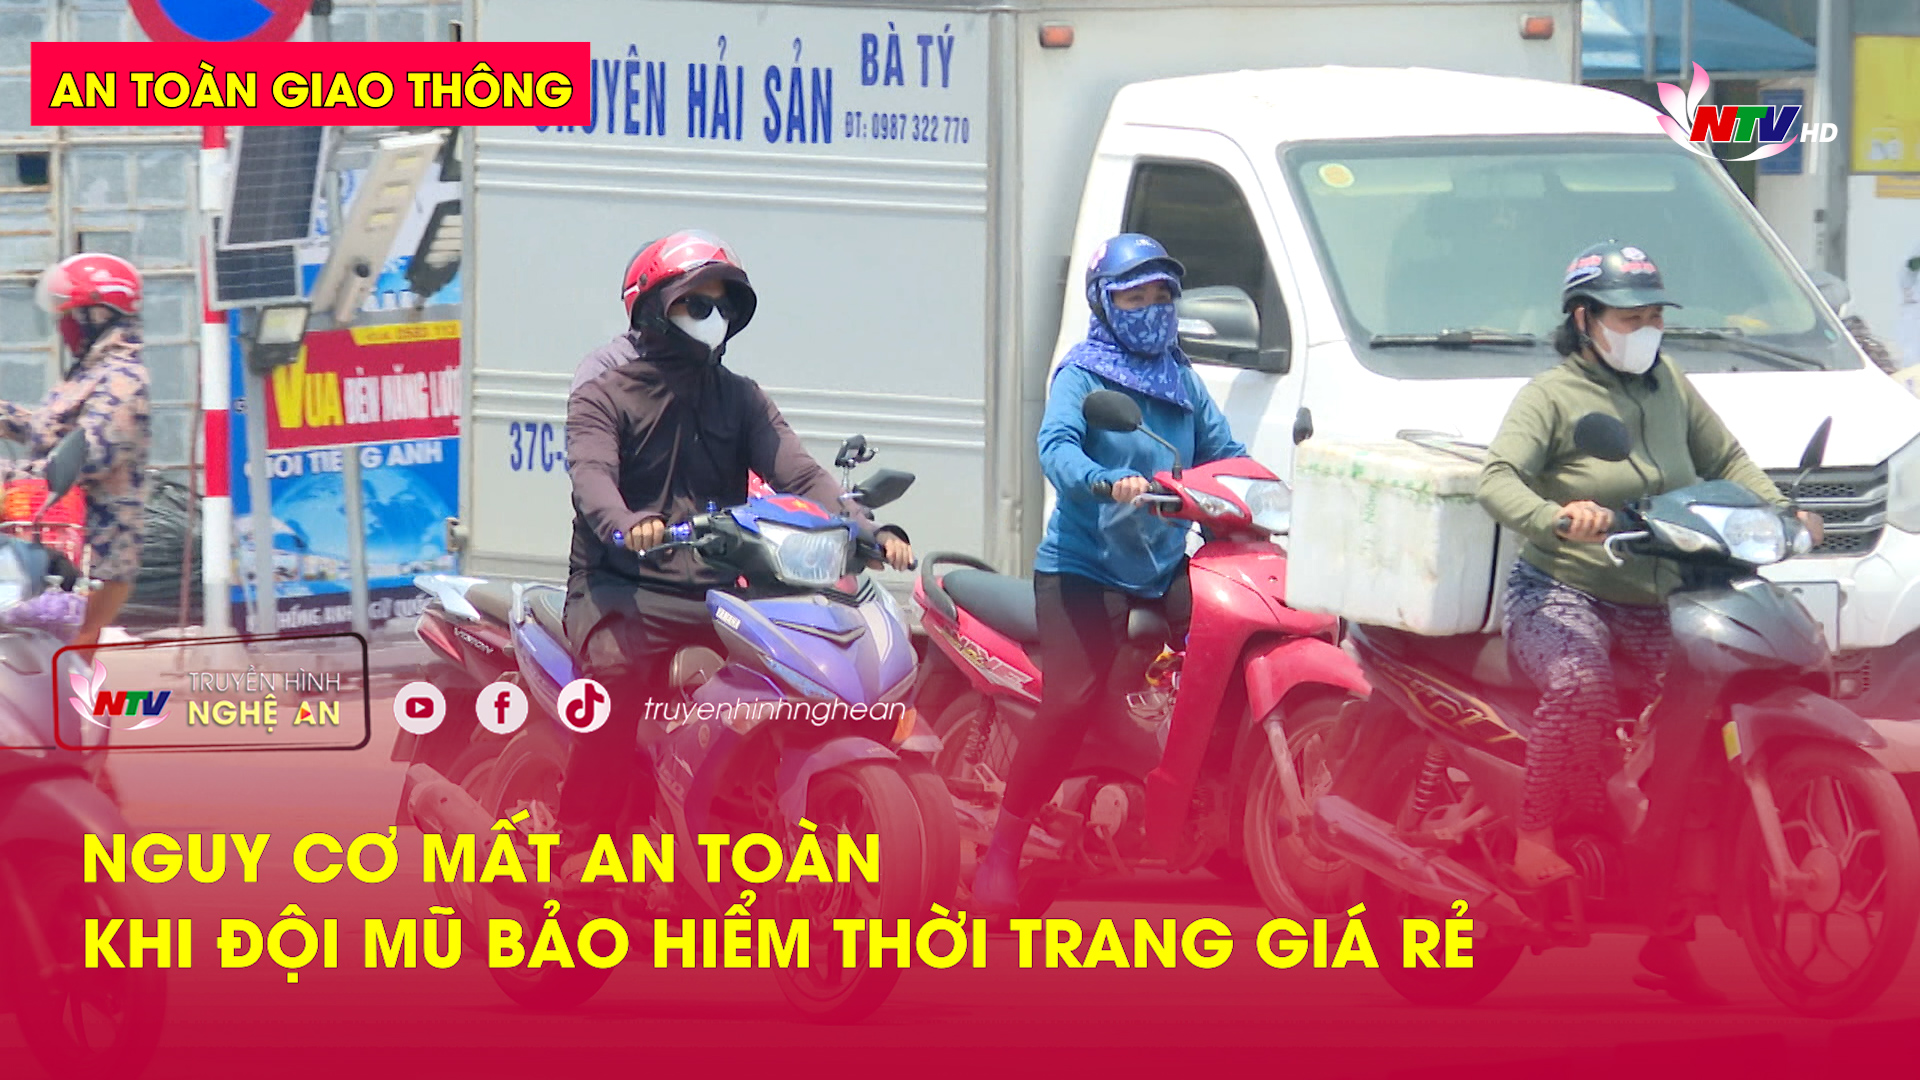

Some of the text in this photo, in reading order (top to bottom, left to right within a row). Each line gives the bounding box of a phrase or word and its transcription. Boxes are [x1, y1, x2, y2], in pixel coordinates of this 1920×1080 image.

[859, 20, 956, 89] BÀ TÝ
[534, 34, 834, 145] UYÊN HẢI SẢN
[844, 110, 970, 144] ĐT: 0987 322 770
[386, 441, 444, 467] ANH
